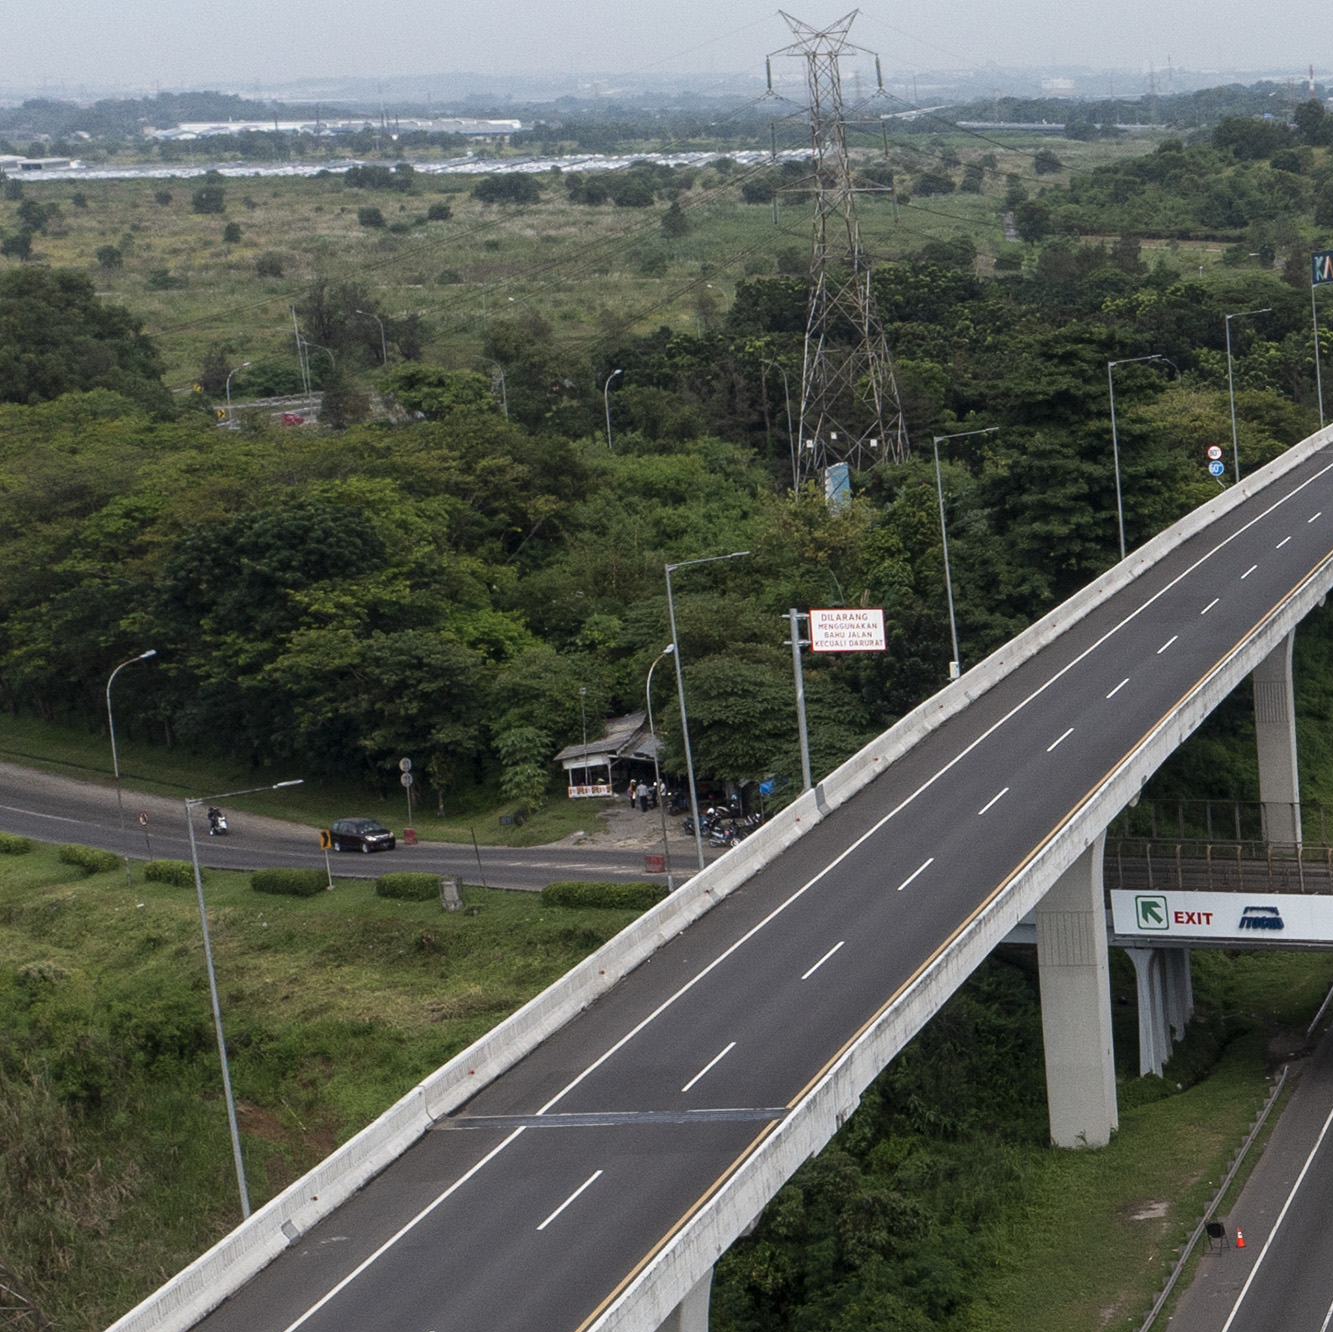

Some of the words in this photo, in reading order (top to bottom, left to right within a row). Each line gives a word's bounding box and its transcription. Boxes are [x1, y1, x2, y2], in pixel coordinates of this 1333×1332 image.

[821, 613, 868, 622] DILARANG
[824, 631, 845, 639] BAHU
[1174, 911, 1214, 925] EXIT
